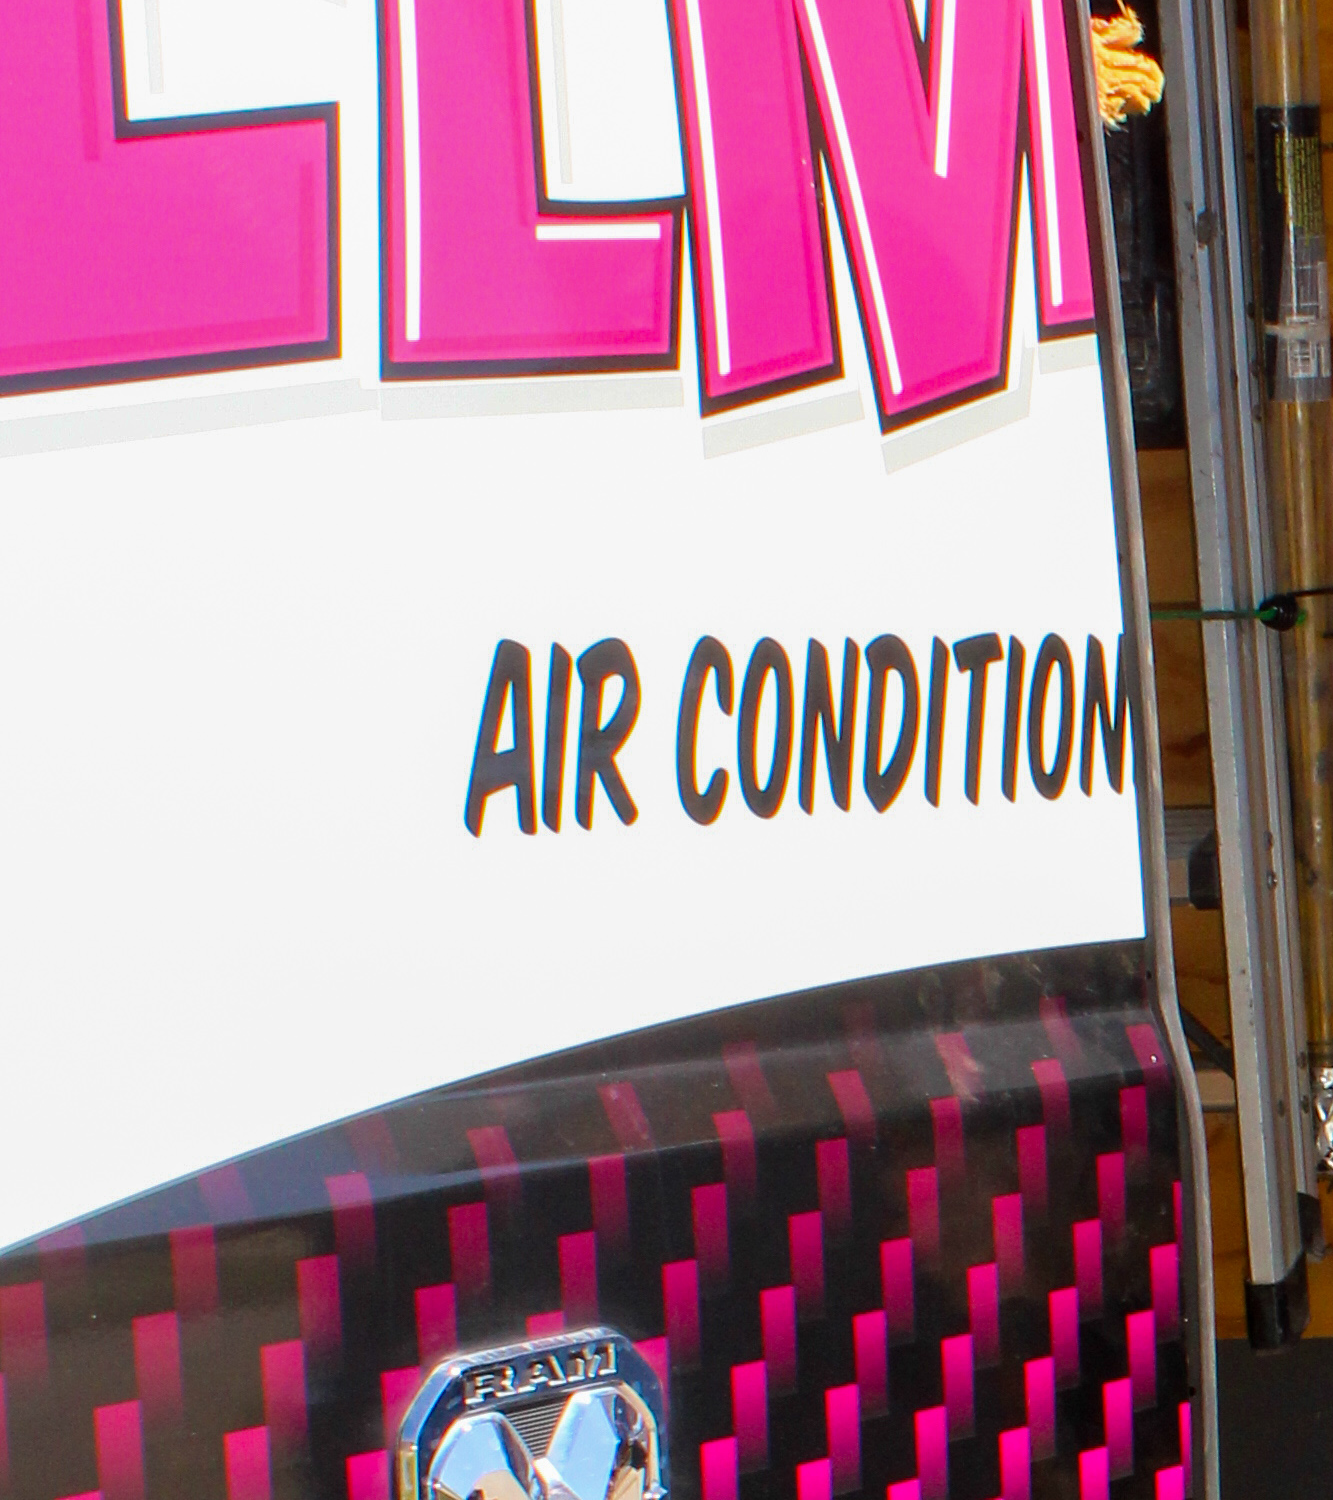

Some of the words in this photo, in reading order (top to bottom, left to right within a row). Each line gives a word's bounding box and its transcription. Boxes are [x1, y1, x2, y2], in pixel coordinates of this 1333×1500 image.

[464, 637, 641, 839] AIR
[676, 631, 1134, 826] CONDITION
[464, 1342, 617, 1405] RAM
